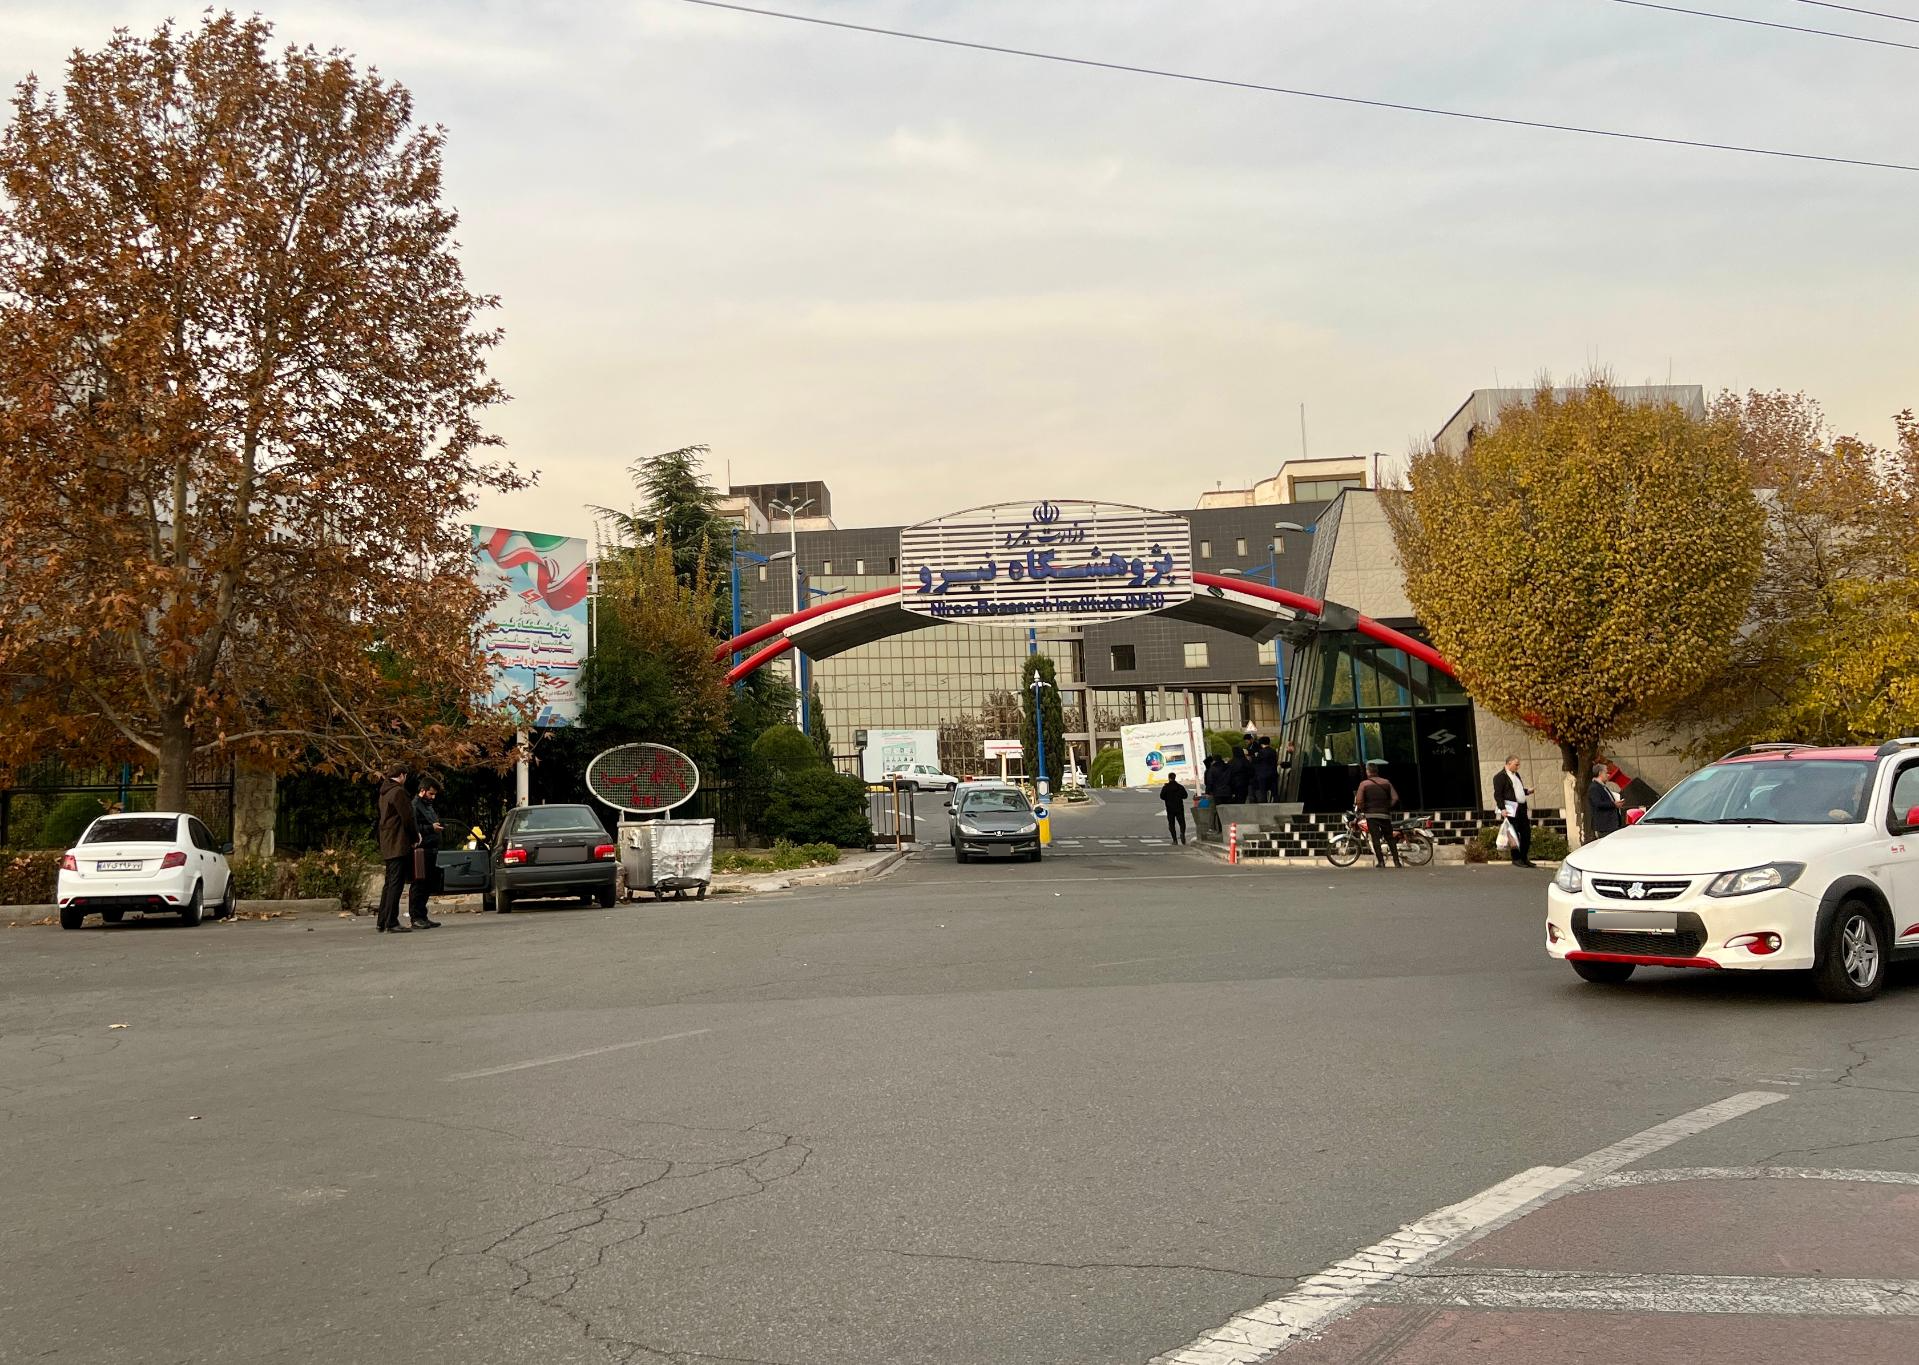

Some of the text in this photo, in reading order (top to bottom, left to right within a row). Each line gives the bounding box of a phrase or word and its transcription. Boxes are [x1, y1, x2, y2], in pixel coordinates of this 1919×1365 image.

[1005, 521, 1085, 549] وزارت نیرو
[917, 543, 1173, 593] پژوهشگاه نیرو
[977, 597, 1054, 616] Research
[1125, 591, 1165, 609] (NRI)
